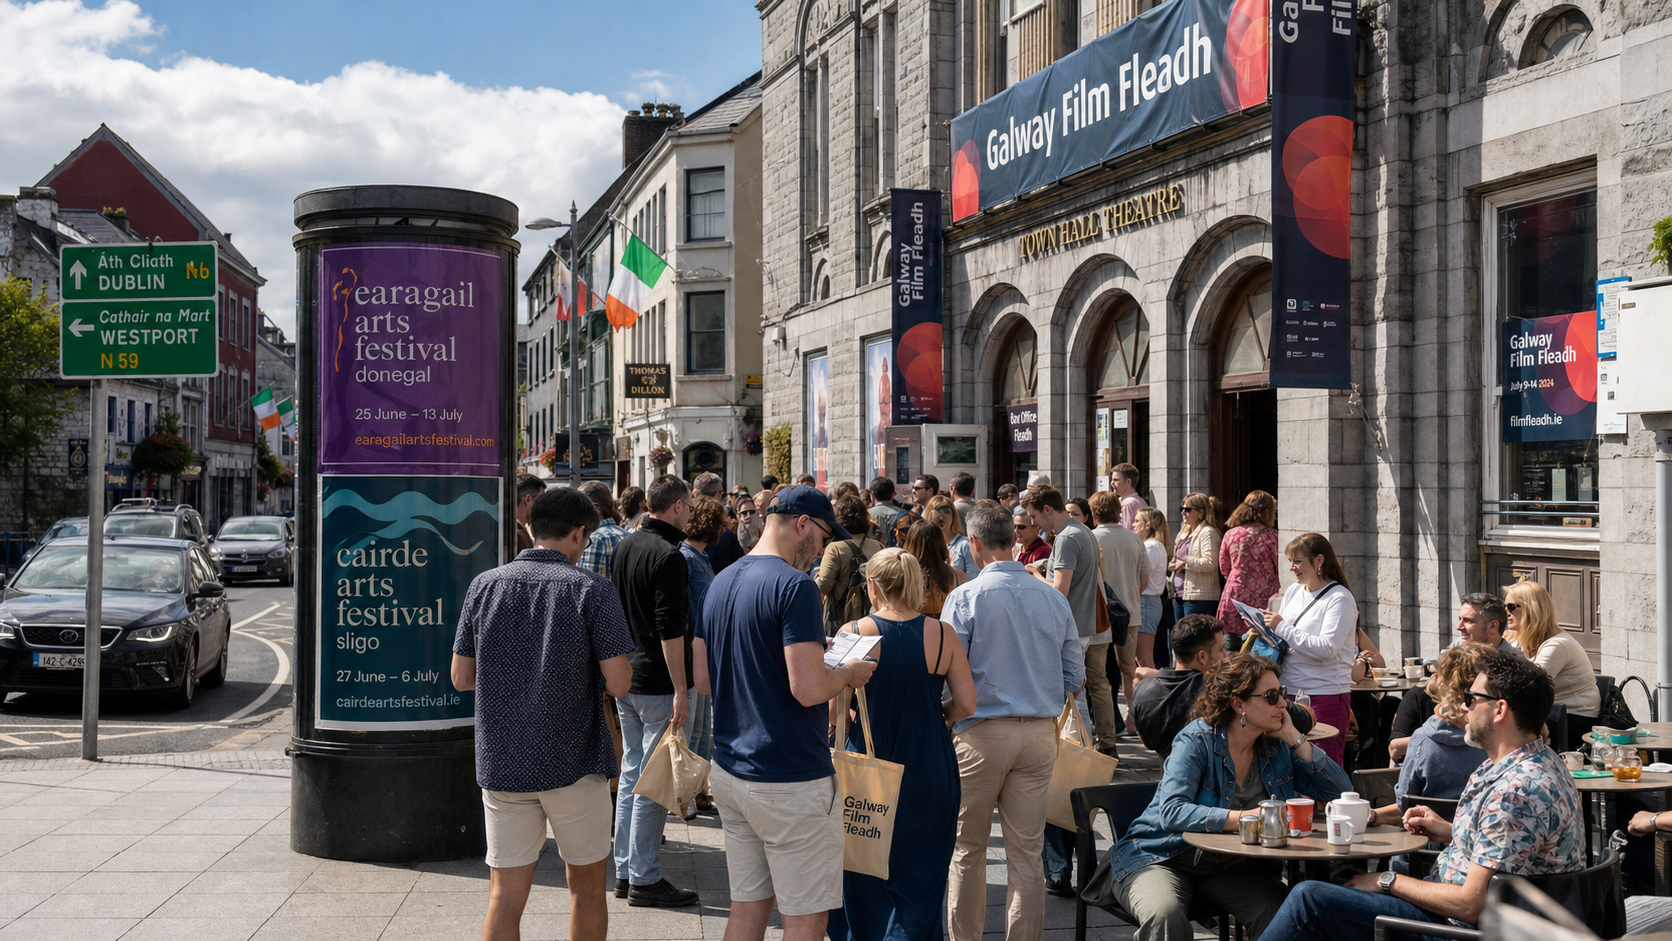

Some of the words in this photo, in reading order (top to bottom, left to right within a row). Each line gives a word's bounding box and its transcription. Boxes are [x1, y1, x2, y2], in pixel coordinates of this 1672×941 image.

[987, 107, 1056, 170] Galway
[1062, 78, 1110, 136] Film
[1119, 22, 1211, 112] Fleadh
[1019, 227, 1057, 257] TOWN
[1060, 211, 1099, 244] HALL
[1104, 184, 1182, 231] THEATRE
[911, 202, 923, 260] Fleadh
[98, 251, 123, 269] Áth
[130, 254, 173, 268] Cliath
[186, 261, 210, 279] N6
[896, 243, 912, 307] Galway
[99, 274, 165, 290] DUBLIN
[911, 266, 923, 300] Film
[354, 281, 474, 312] earagail
[100, 310, 149, 324] Cathair
[155, 312, 172, 323] na
[178, 309, 210, 322] Mart
[355, 311, 410, 333] arts
[100, 329, 199, 345] WESTPORT
[1510, 331, 1553, 350] Galway
[355, 335, 457, 361] festival
[1510, 350, 1534, 367] Film
[1538, 345, 1576, 365] Fleadh
[101, 353, 113, 369] N
[118, 353, 139, 369] 59
[355, 366, 431, 386] donegal
[629, 367, 666, 375] THOMAS
[631, 386, 665, 394] DILLON
[1510, 381, 1523, 392] July
[1539, 379, 1554, 388] 2024
[355, 408, 371, 420] 25
[374, 408, 407, 420] June
[423, 409, 437, 420] 13
[439, 409, 463, 423] July
[1510, 413, 1562, 427] filmfleadh.ie
[355, 433, 495, 448] earagailartsfestival.com
[336, 539, 428, 568] cairde
[337, 573, 394, 597] arts
[336, 598, 444, 626] festival
[336, 632, 380, 654] sligo
[336, 670, 351, 682] 27
[354, 670, 386, 682] June
[402, 670, 411, 682] 6
[413, 670, 439, 684] July
[336, 693, 461, 709] cairdeartsfestival.ie
[844, 796, 889, 816] Galway
[843, 809, 870, 824] Film
